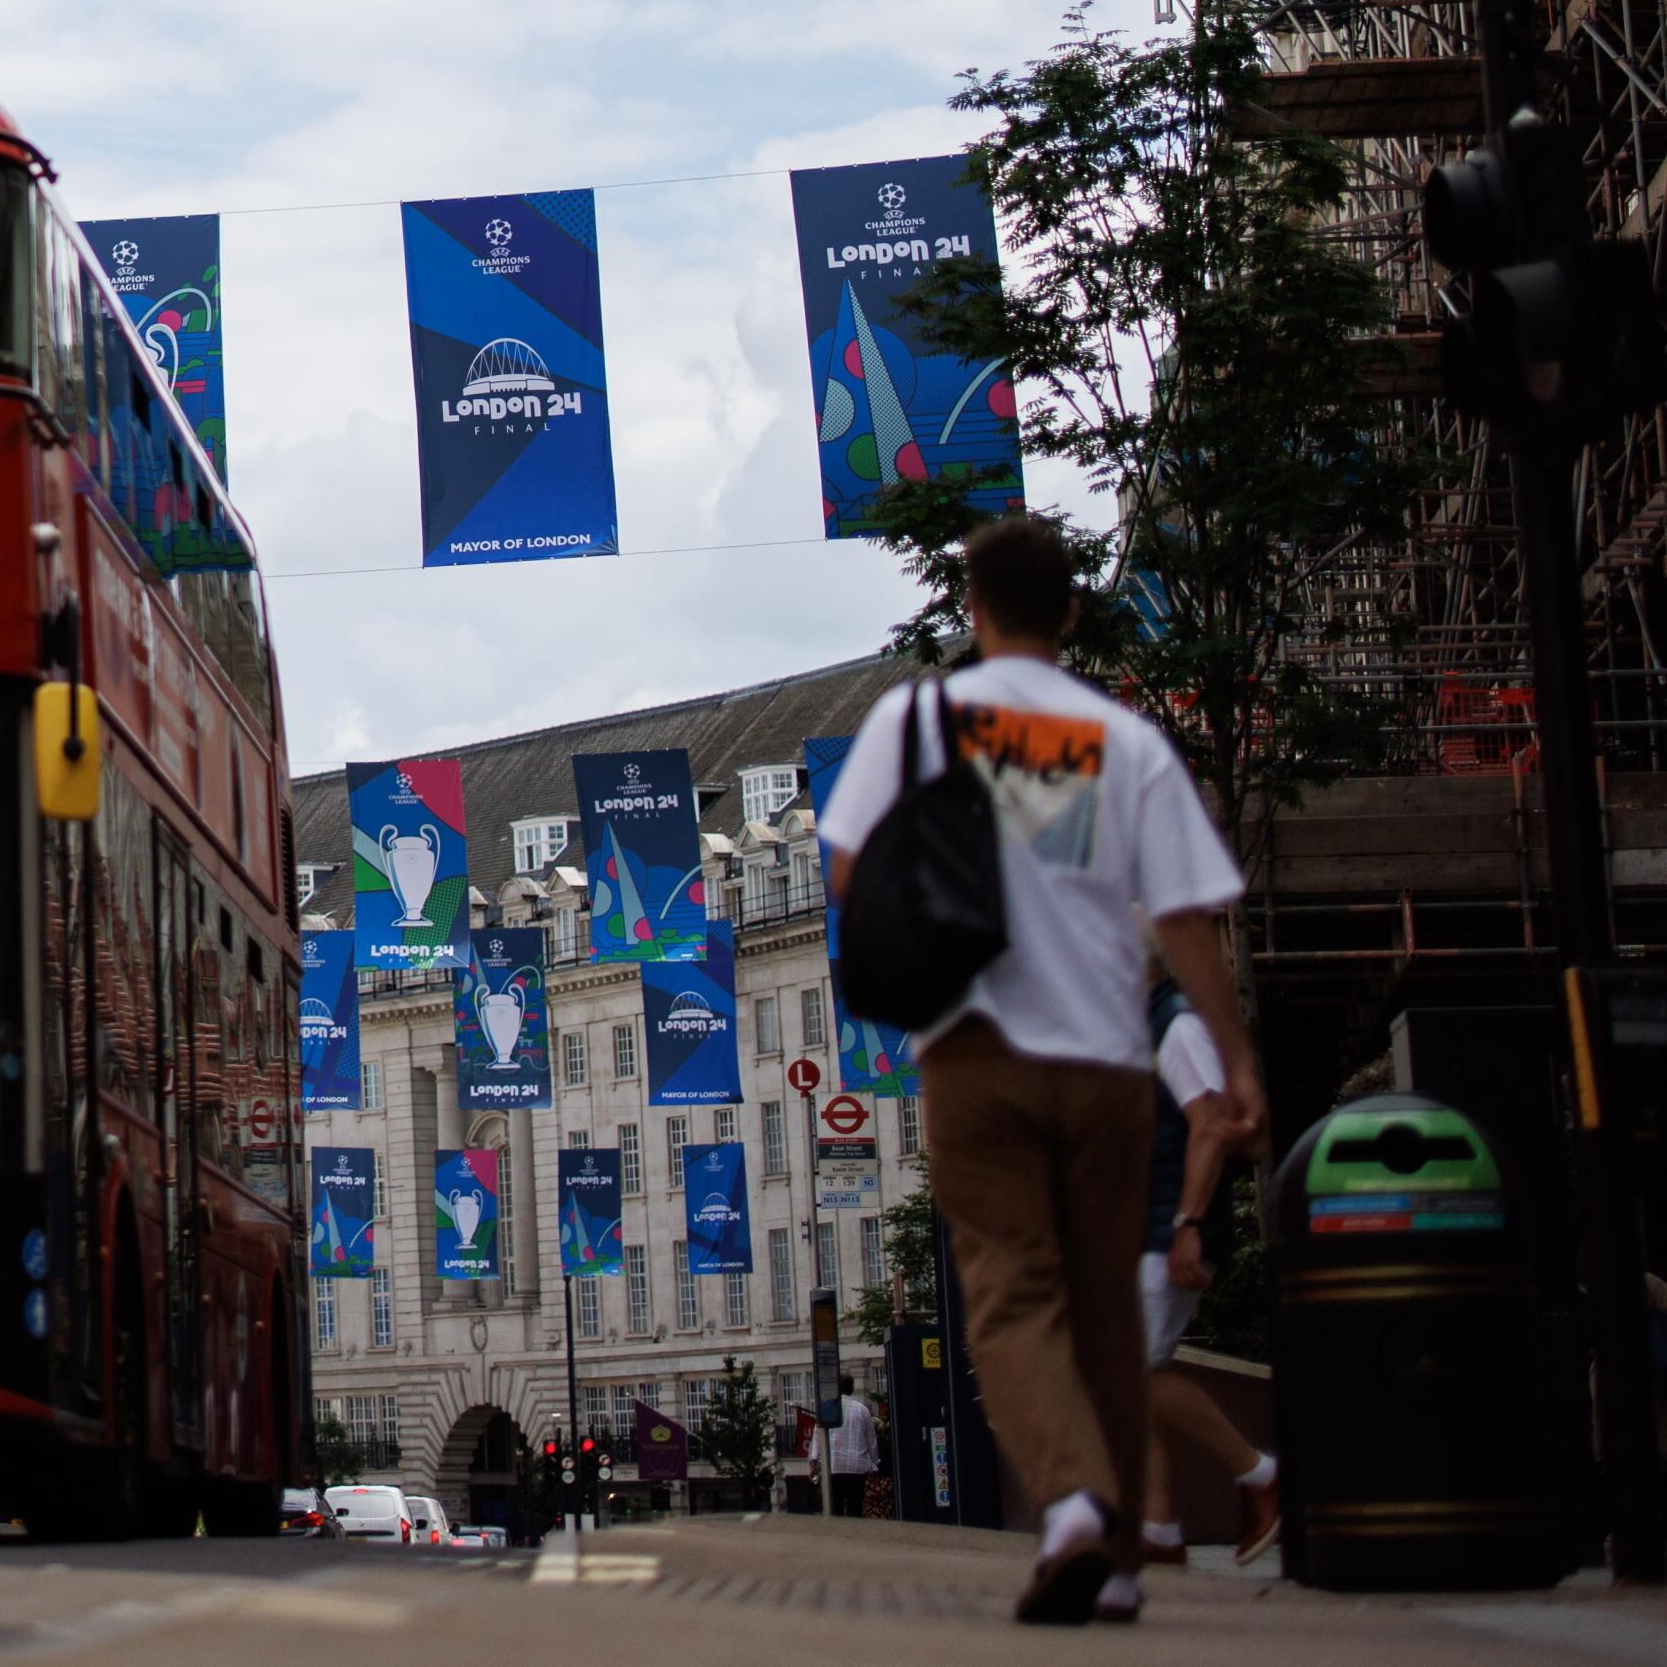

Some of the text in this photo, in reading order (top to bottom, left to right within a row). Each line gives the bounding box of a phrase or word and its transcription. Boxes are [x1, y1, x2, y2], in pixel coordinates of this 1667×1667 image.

[865, 217, 925, 230] CHAMPIONS
[877, 226, 916, 237] LEAGUE
[935, 235, 970, 259] 24
[472, 255, 531, 268] CHAMPIONS
[483, 265, 522, 275] LEAGUE
[861, 265, 939, 280] FINAL
[113, 283, 145, 292] EAGUE
[547, 392, 581, 415] 24
[474, 422, 551, 435] FINAL
[450, 534, 591, 553] MAYOR OF LONDON
[657, 794, 679, 808] 24
[615, 812, 660, 820] FINAL
[434, 945, 454, 956] 24
[709, 1019, 727, 1031] 24
[329, 1026, 347, 1038] 24
[796, 1064, 812, 1086] L
[521, 1084, 539, 1096] 24
[354, 1175, 366, 1185] 24
[601, 1175, 613, 1184] 24
[728, 1211, 740, 1220] 24
[478, 1260, 490, 1269] 24
